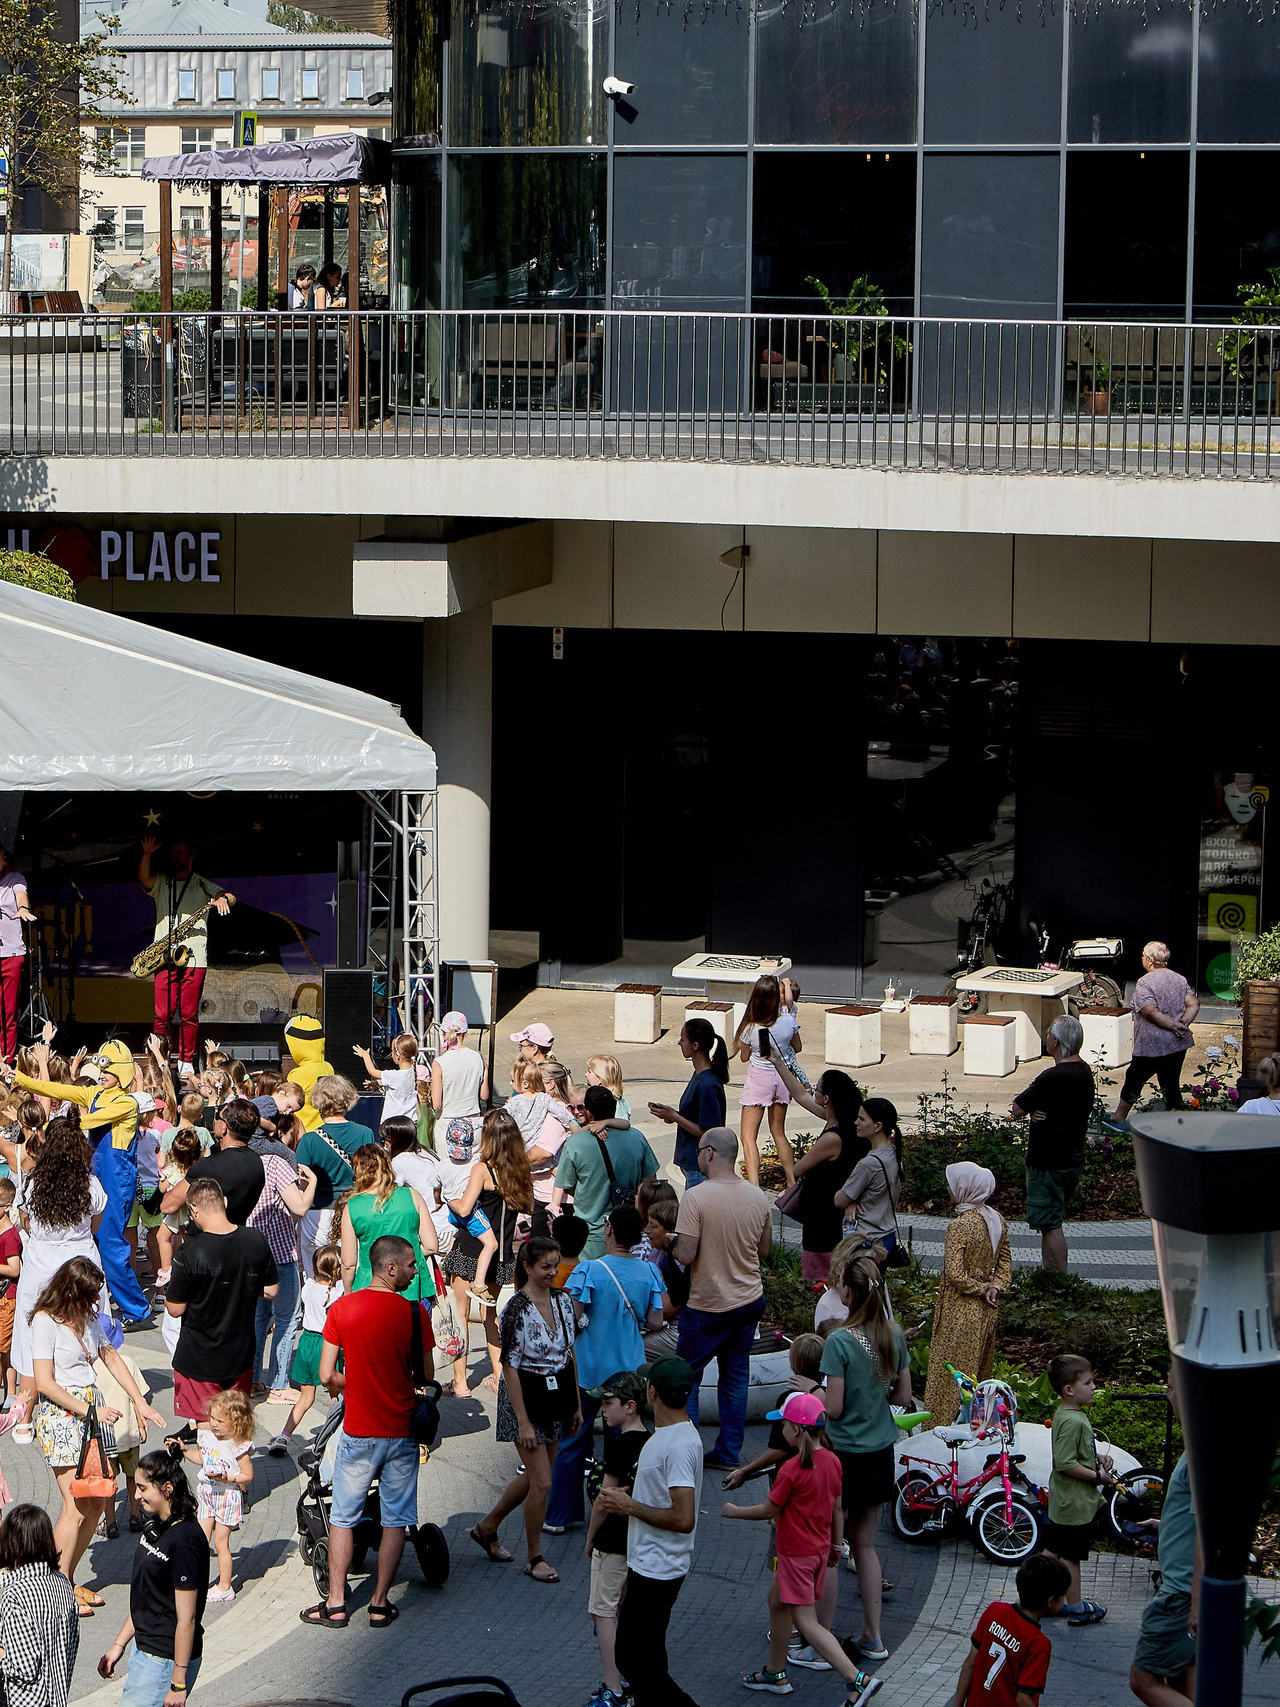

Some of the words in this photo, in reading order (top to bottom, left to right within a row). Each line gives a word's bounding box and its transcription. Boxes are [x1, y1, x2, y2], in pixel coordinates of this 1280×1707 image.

[101, 530, 220, 583] PLACE
[1205, 837, 1236, 848] ВХОД
[1204, 849, 1250, 860] ТОЛЬКО
[1204, 862, 1229, 872] ДЛЯ
[1213, 968, 1238, 977] Delive
[1213, 976, 1233, 985] Club
[140, 1534, 170, 1562] hampion
[983, 1641, 1007, 1691] 7
